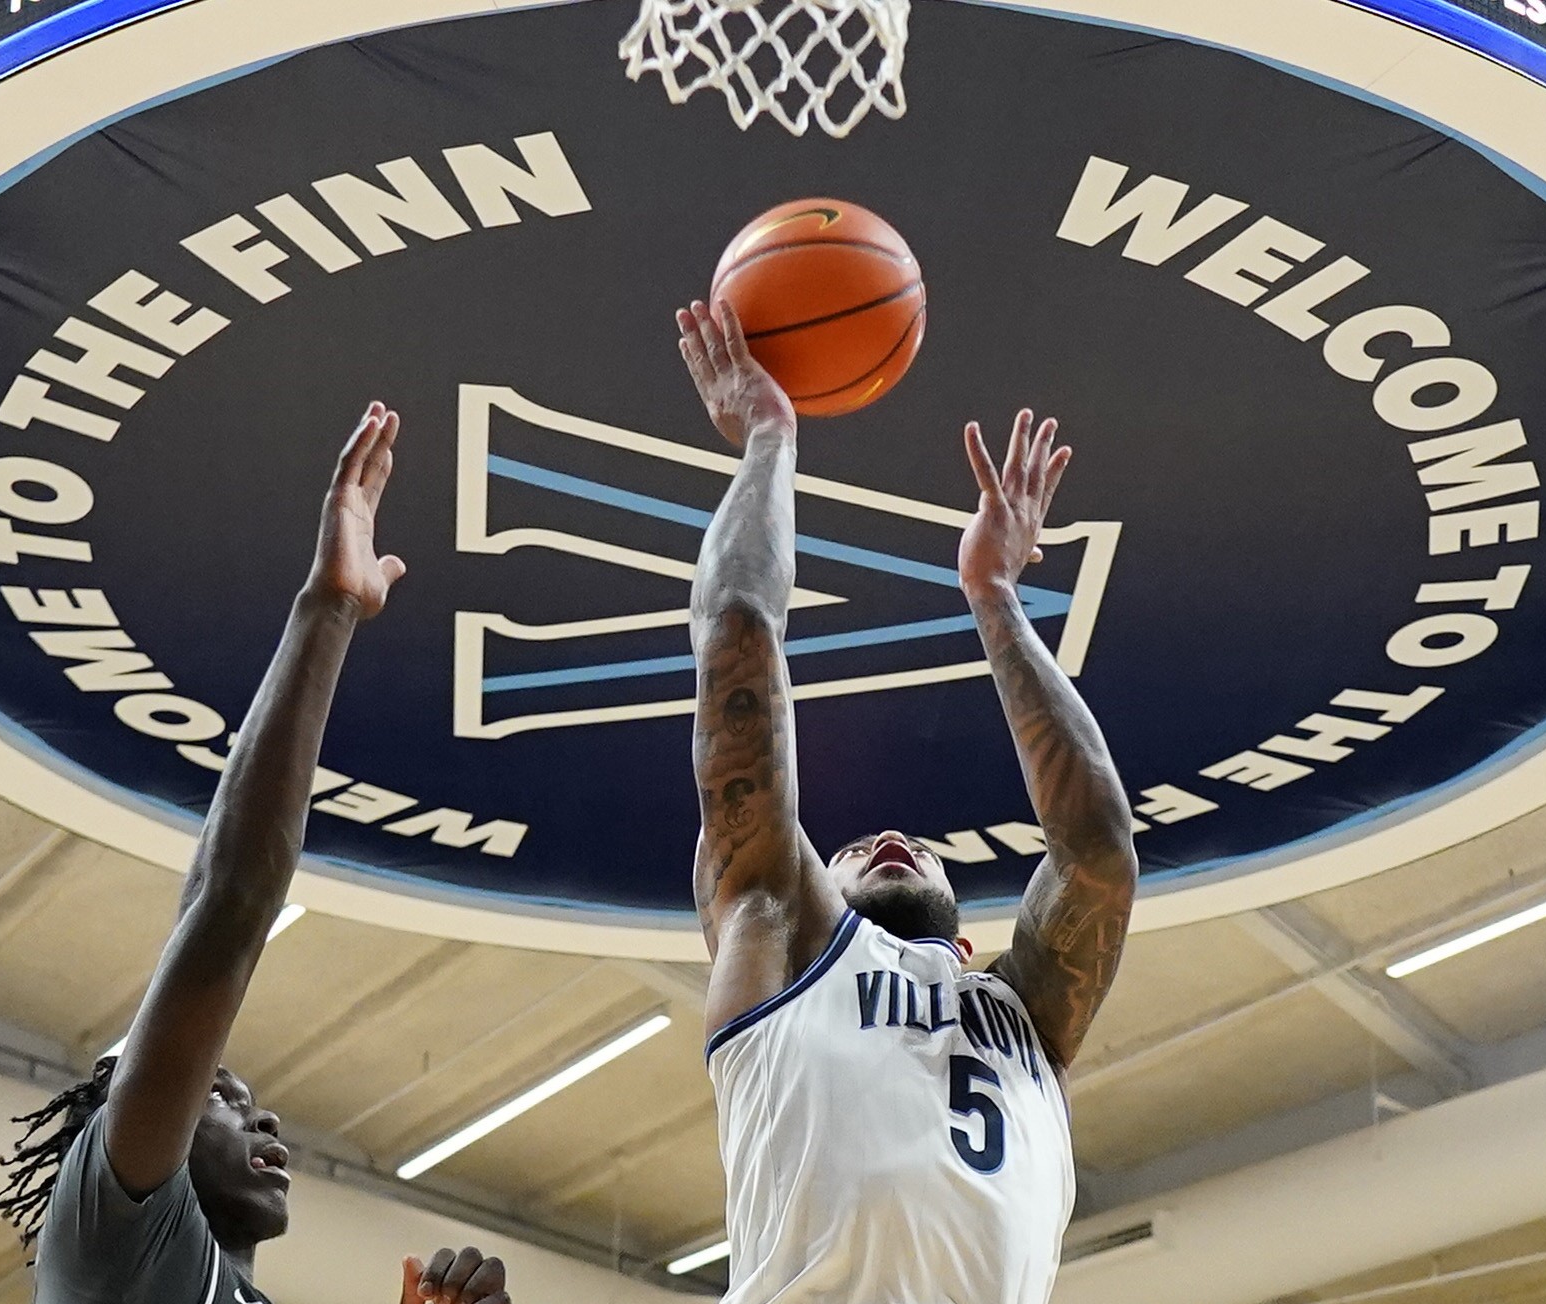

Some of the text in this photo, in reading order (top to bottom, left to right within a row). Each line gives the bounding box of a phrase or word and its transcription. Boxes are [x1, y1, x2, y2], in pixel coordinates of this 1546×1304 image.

[180, 131, 593, 304] FINN
[1055, 155, 1541, 556] WELCOME
[1386, 564, 1531, 668] TO
[1200, 686, 1445, 792] THE
[948, 1054, 1006, 1176] 5
